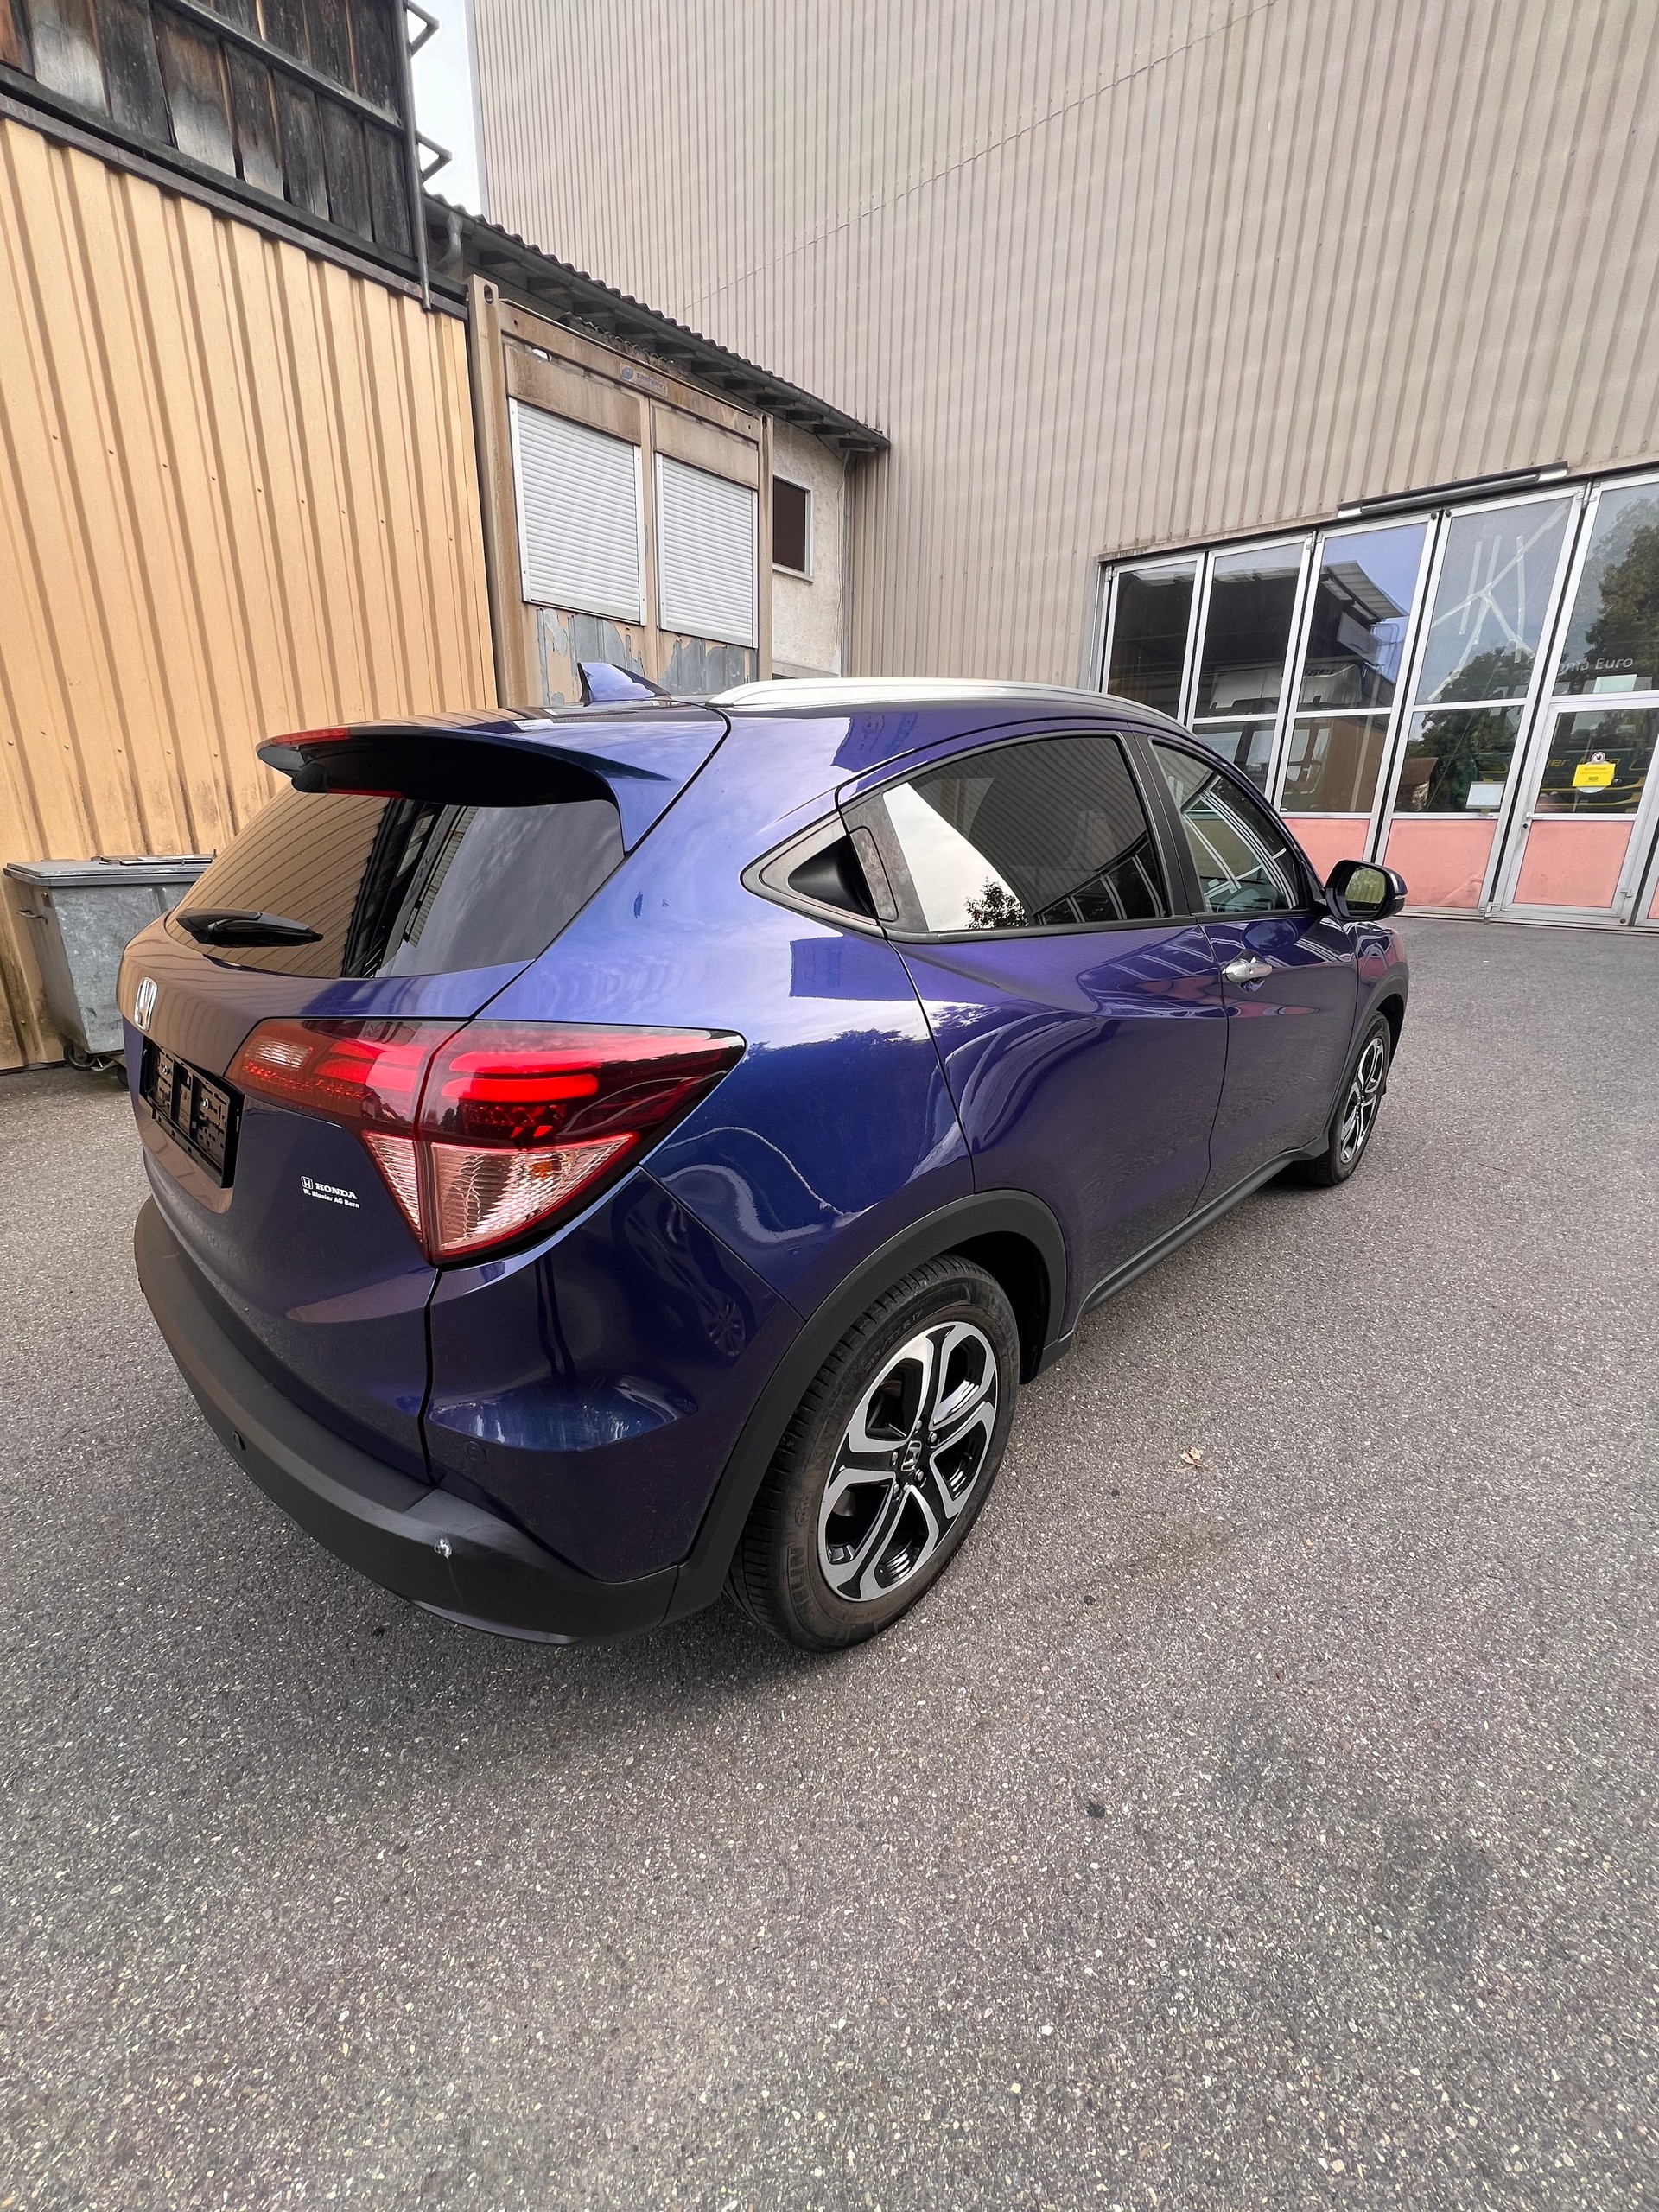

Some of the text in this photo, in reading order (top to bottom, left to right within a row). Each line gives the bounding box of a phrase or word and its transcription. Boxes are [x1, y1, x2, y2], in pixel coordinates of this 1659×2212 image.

[1595, 658, 1634, 670] Euro
[315, 1183, 358, 1199] HONDA
[344, 1199, 360, 1209] Bern
